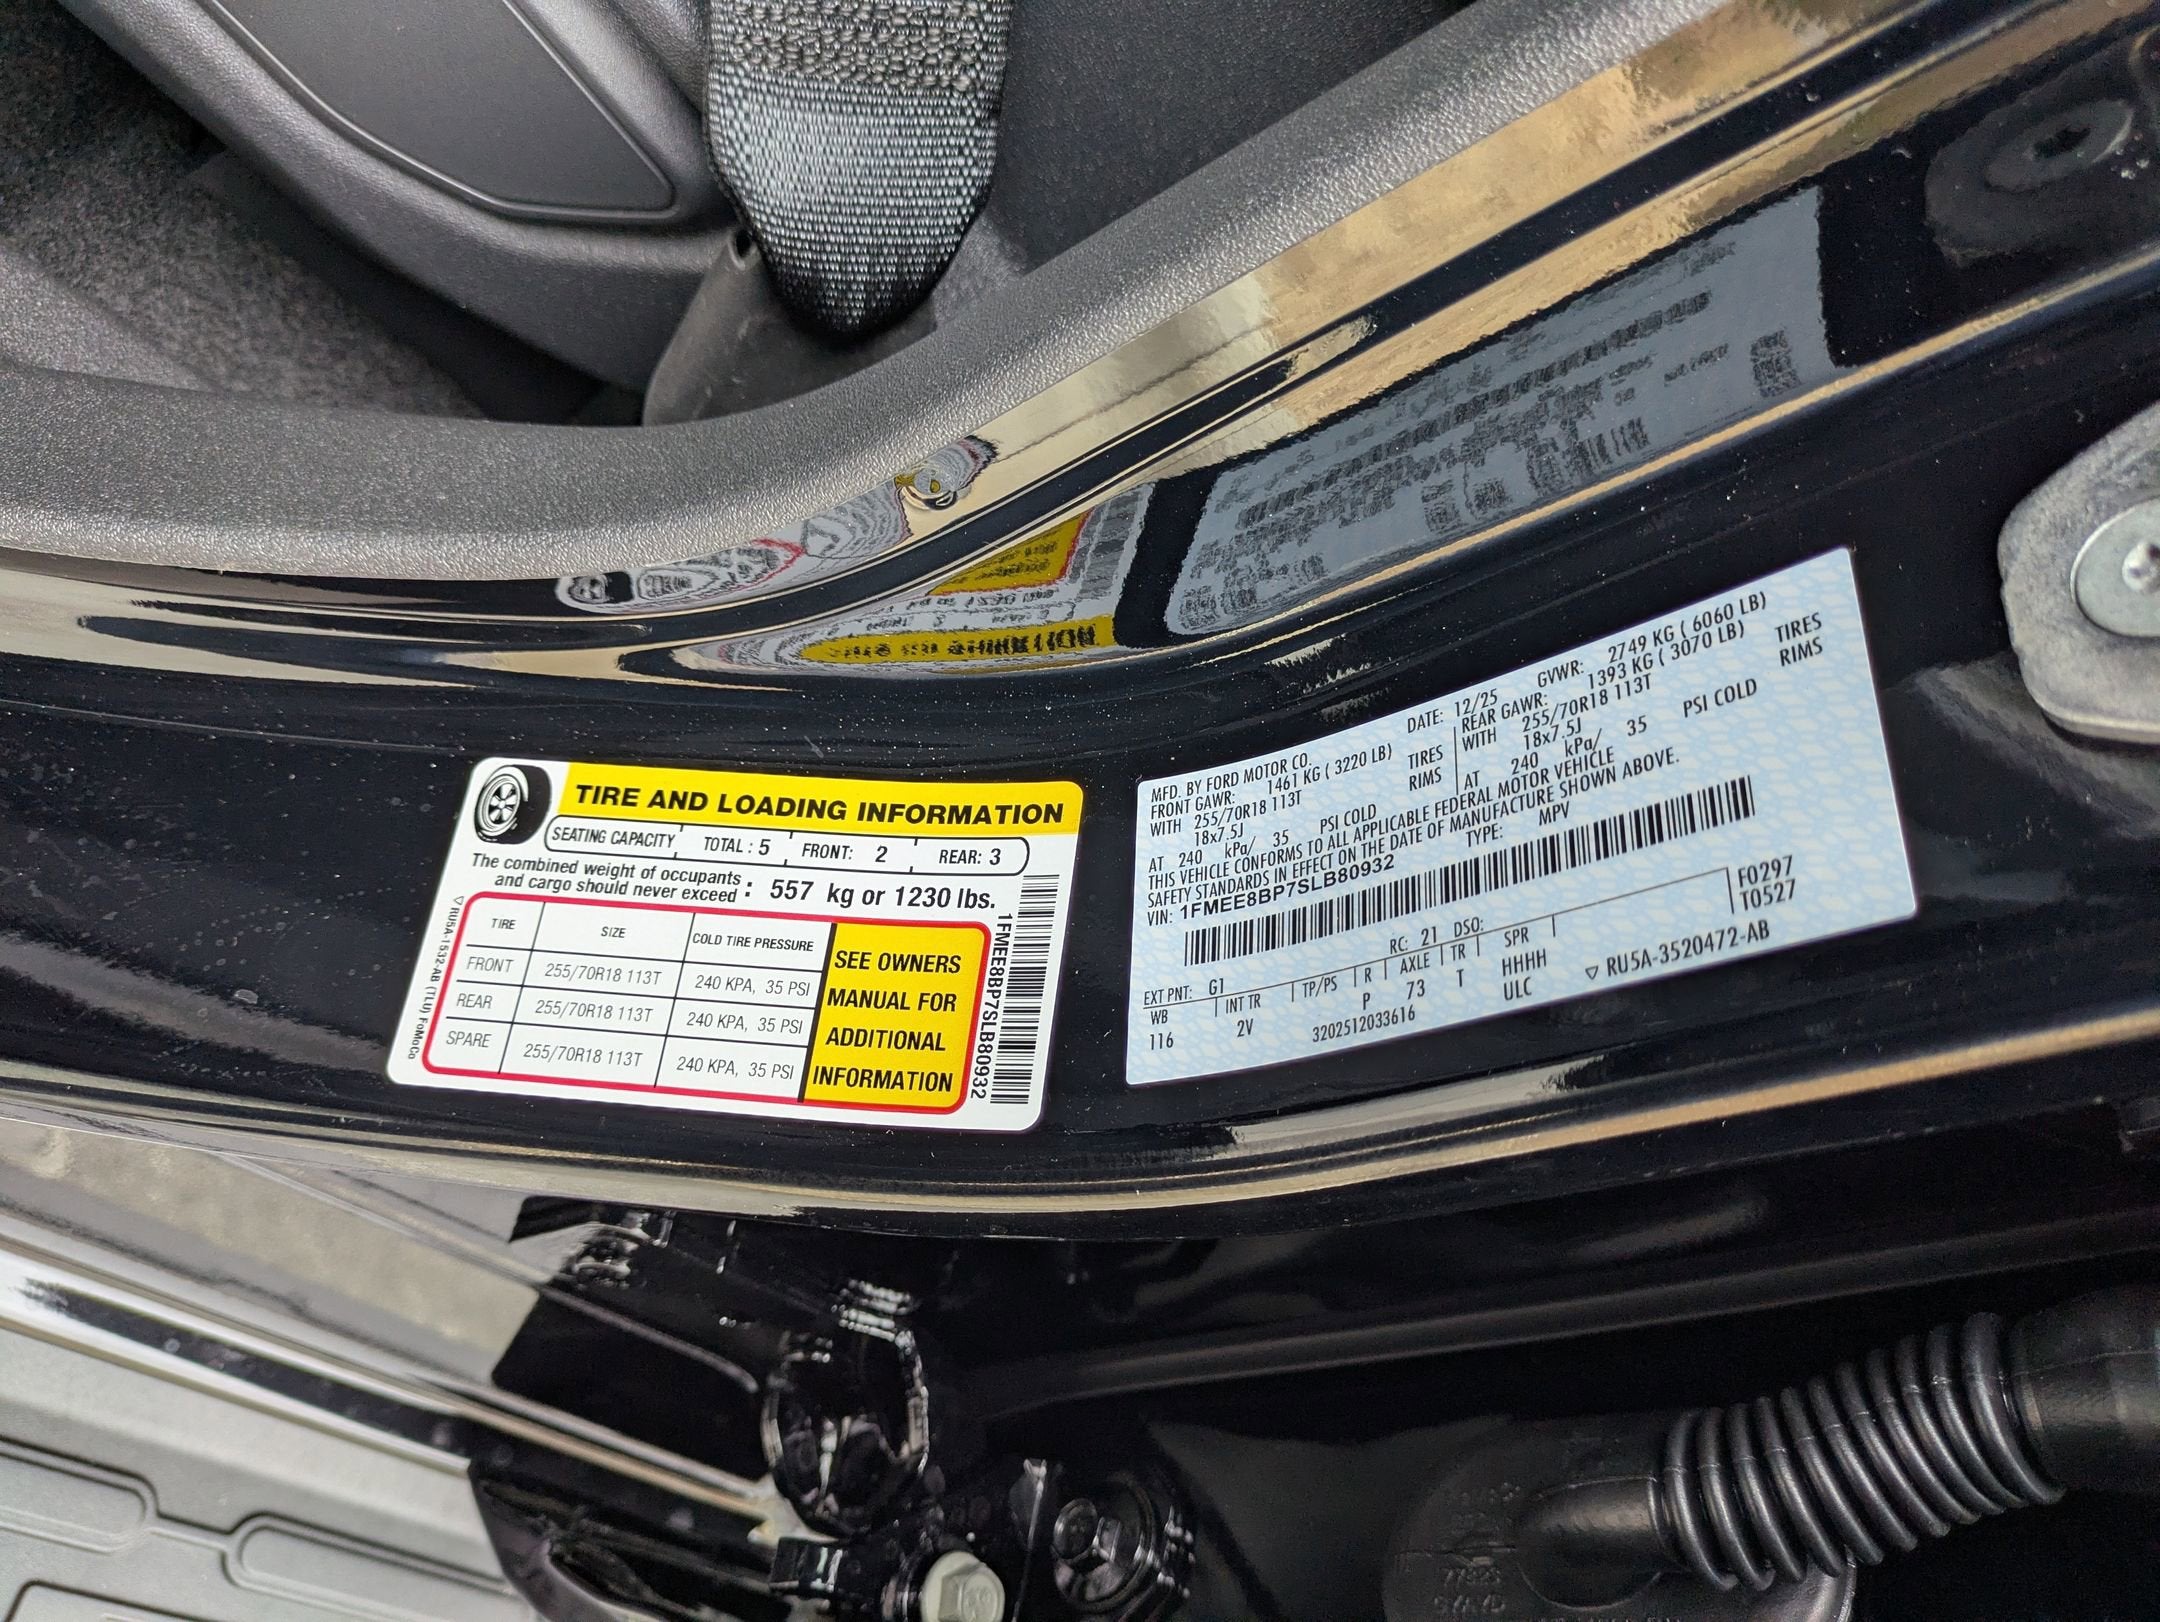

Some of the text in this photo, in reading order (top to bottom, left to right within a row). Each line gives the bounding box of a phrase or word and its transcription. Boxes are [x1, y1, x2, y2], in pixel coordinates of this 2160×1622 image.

[1537, 591, 1767, 688] GVWR: 2749 KG 6060 LB)
[1462, 619, 1745, 733] REAR GAWR: 1393 KG 3070 LB)
[1462, 612, 1822, 752] WITH 255/70R18 113T TIRES
[1524, 636, 1824, 750] 18x7.5J RIMS
[1407, 688, 1498, 733] DATE: 12/25
[1464, 678, 1757, 791] AT 240 kPa/ 35 PSI COLD
[1150, 744, 1443, 838] WITH 255/70R18 113T TIRES
[1151, 752, 1312, 803] MFD. BY FORD MOTOR CO.
[1151, 743, 1392, 820] FRONT GAWR: 1461 KG 3220 LB)
[576, 784, 1064, 825] TIRE AND LOADING INFORMATION
[1149, 746, 1615, 890] THIS VEHICLE CONFORMS TO ALL APPLICABLE FEDERAL MOTOR VEHICLE
[1194, 766, 1442, 847] 18x7.5J RIMS
[552, 827, 676, 849] SEATING CAPACITY
[1148, 747, 1680, 908] SAFETY STANDARDS IN EFFECT ON THE DATE OF MANUFACTURE SHOWN ABOVE.
[1148, 803, 1377, 873] AT 240 kPa/ 35 PSI COLD
[1466, 801, 1569, 848] TYPE: MPV
[758, 838, 772, 856] 5
[802, 843, 888, 863] FRONT: 2
[938, 848, 1001, 866] REAR: 3
[471, 853, 742, 888] The combined weight of occupants
[494, 873, 996, 909] and cargo should never exceed 557 kg or 1230 lbs.
[1147, 854, 1394, 927] VIN: 1FMEE8BP7SLB80932
[491, 918, 517, 930] TIRE
[600, 926, 627, 938] SIZE
[692, 933, 814, 952] COLD TIRE PRESSURE
[1606, 919, 1770, 977] RU5A-3520472-AB
[466, 956, 514, 973] FRONT
[544, 963, 662, 986] 255/70R18 113T
[834, 950, 962, 973] SEE OWNERS
[1151, 927, 1529, 1025] WB INT TP/PS AXLE SPR
[418, 986, 438, 1014] (TLU)
[456, 993, 493, 1009] REAR
[695, 974, 811, 997] 240 KPA, 35 PSI
[827, 988, 957, 1012] MANUAL FOR
[1144, 978, 1224, 1005] EXT PNT: G1
[1150, 948, 1547, 1051] 116 2V 73 HHHH
[1503, 976, 1532, 1001] ULC
[535, 1000, 654, 1023] 255/70R18 113T
[686, 1011, 803, 1034] 240 KPA, 35 PSI
[970, 913, 1013, 1100] 1FMEE8BP7SLB80932
[1312, 1004, 1416, 1043] 3202512033616
[408, 1017, 428, 1060] FoMoCo
[446, 1030, 492, 1048] SPARE
[523, 1043, 643, 1067] 255/70R18 113T
[825, 1027, 946, 1051] ADDITIONAL
[676, 1056, 795, 1080] 240 KPA, 35 PSI
[812, 1066, 953, 1092] INFORMATION
